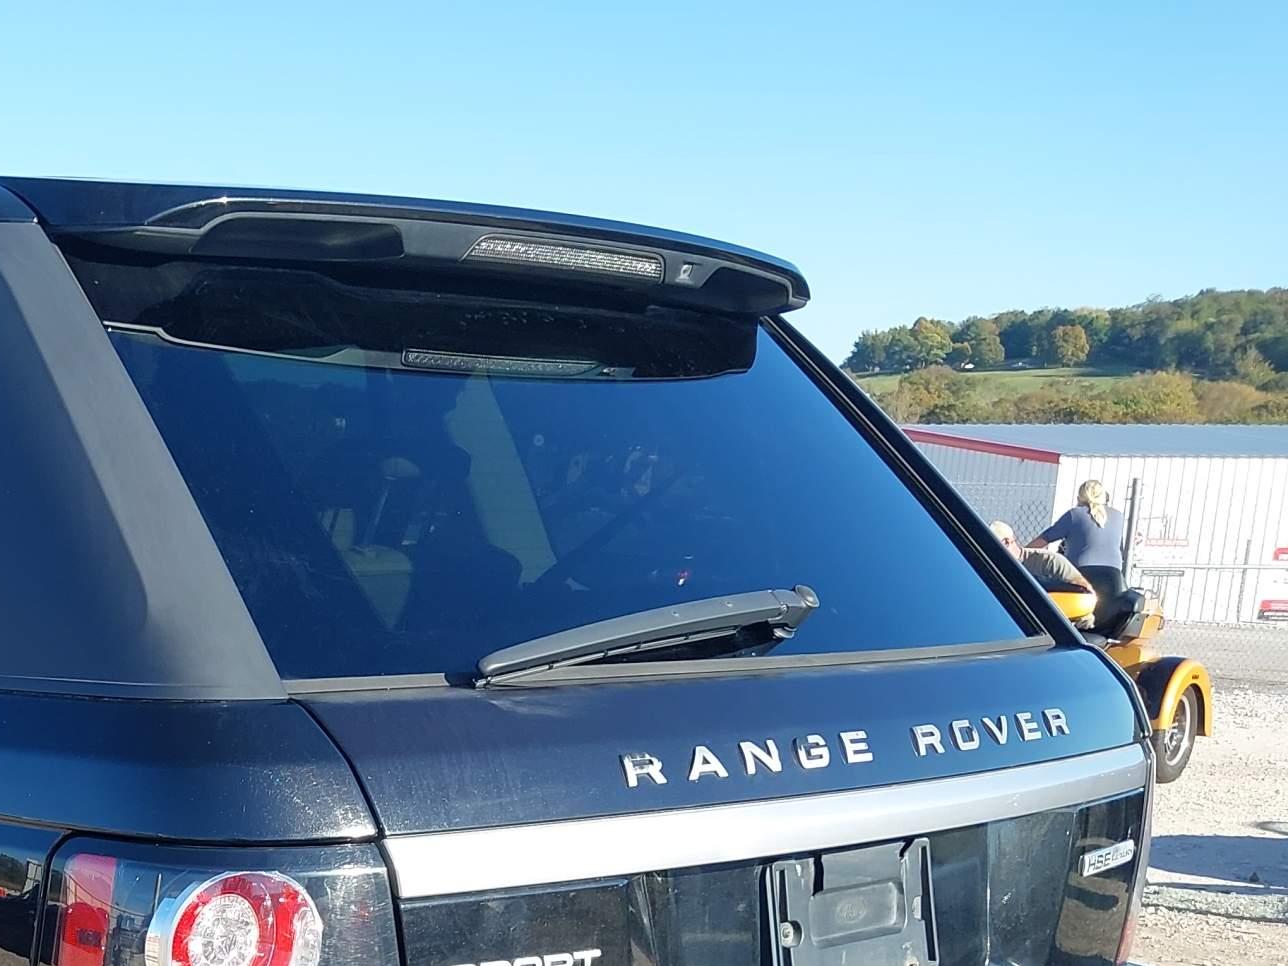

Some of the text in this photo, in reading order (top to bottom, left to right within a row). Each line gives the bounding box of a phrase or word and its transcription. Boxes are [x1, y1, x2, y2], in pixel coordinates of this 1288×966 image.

[620, 708, 1070, 787] RANGE ROVER
[1086, 851, 1111, 873] HSE
